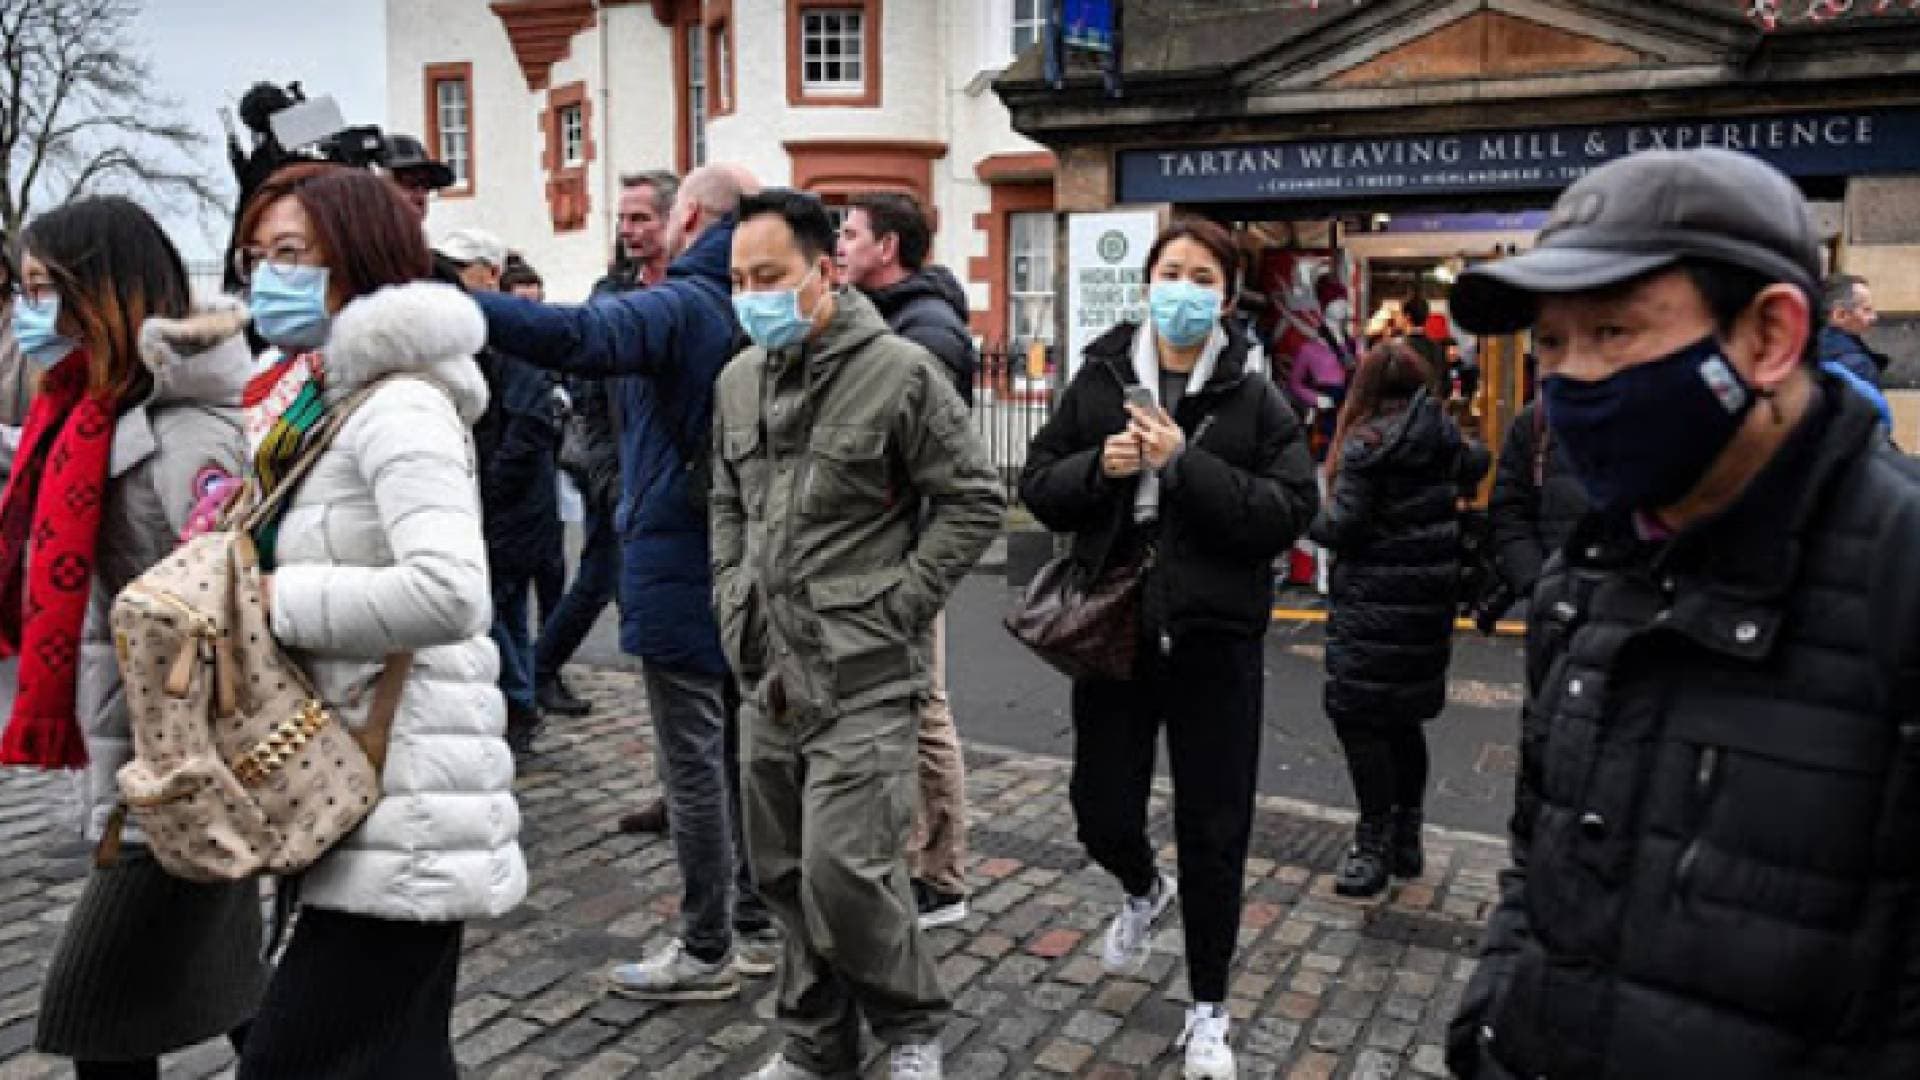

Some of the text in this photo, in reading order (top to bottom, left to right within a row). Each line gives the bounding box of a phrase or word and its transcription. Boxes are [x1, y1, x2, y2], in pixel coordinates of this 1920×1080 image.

[1159, 116, 1873, 176] TARTAN WEAVING MILL & EXPERIENCE
